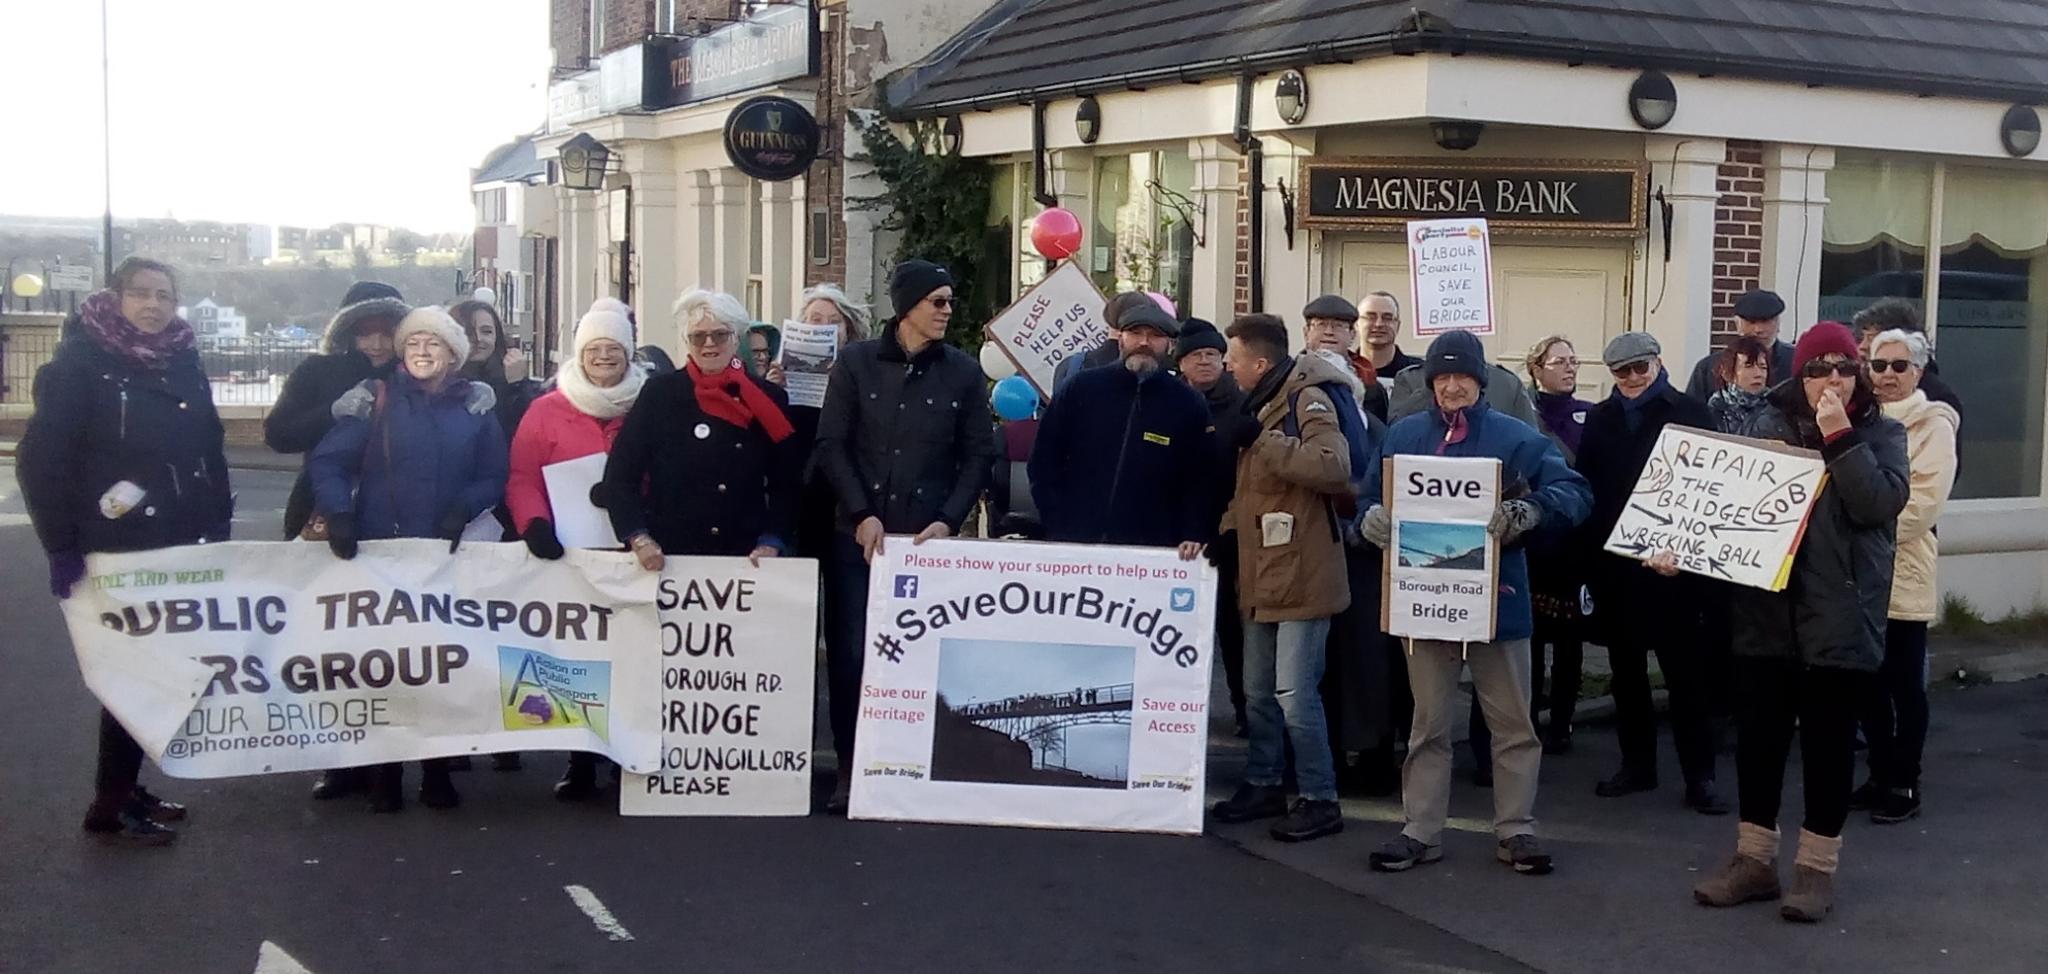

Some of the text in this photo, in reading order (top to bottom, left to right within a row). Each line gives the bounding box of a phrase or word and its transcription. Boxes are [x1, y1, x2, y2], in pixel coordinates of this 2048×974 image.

[671, 56, 691, 88] THE
[740, 131, 808, 149] GUINNESS
[1335, 176, 1580, 215] MAGNESIA BANK
[1421, 245, 1477, 261] LABOUR
[1438, 279, 1472, 293] SAVE
[1012, 294, 1051, 348] PLEASE
[1030, 303, 1086, 354] HELP US
[1429, 308, 1481, 325] BRIDGE
[1043, 318, 1098, 367] TO SAVE
[1674, 439, 1776, 485] REPAIR
[1407, 471, 1481, 498] Save
[1681, 476, 1724, 497] THE
[1656, 489, 1751, 526] BRIDGE
[1677, 516, 1707, 536] NO
[1620, 523, 1762, 568] WRECKING BALL
[134, 569, 168, 586] AND
[176, 568, 225, 584] WEAR
[904, 554, 1188, 580] Please show your support to help us to
[657, 578, 756, 611] SAVE
[1399, 580, 1484, 596] Borough Road
[316, 588, 612, 641] TRANSPORT
[1412, 602, 1469, 623] Bridge
[873, 581, 1199, 669] #SaveOurBridge
[661, 622, 735, 658] OUR
[281, 644, 469, 695] GROUP
[538, 667, 570, 685] Public
[571, 667, 587, 676] on
[662, 669, 783, 693] OROUGH RD.
[863, 685, 928, 700] Save our
[862, 705, 926, 724] Heritage
[1141, 697, 1205, 713] Save our
[186, 698, 390, 737] OUR BRIDGE
[1147, 719, 1197, 734] Access
[166, 727, 366, 759] @phonecoop.coop
[661, 746, 806, 772] OUNCILLORS
[863, 766, 925, 780] Save Our Bridge
[646, 776, 730, 796] PLEASE
[1131, 779, 1193, 793] Save Our Bridge
